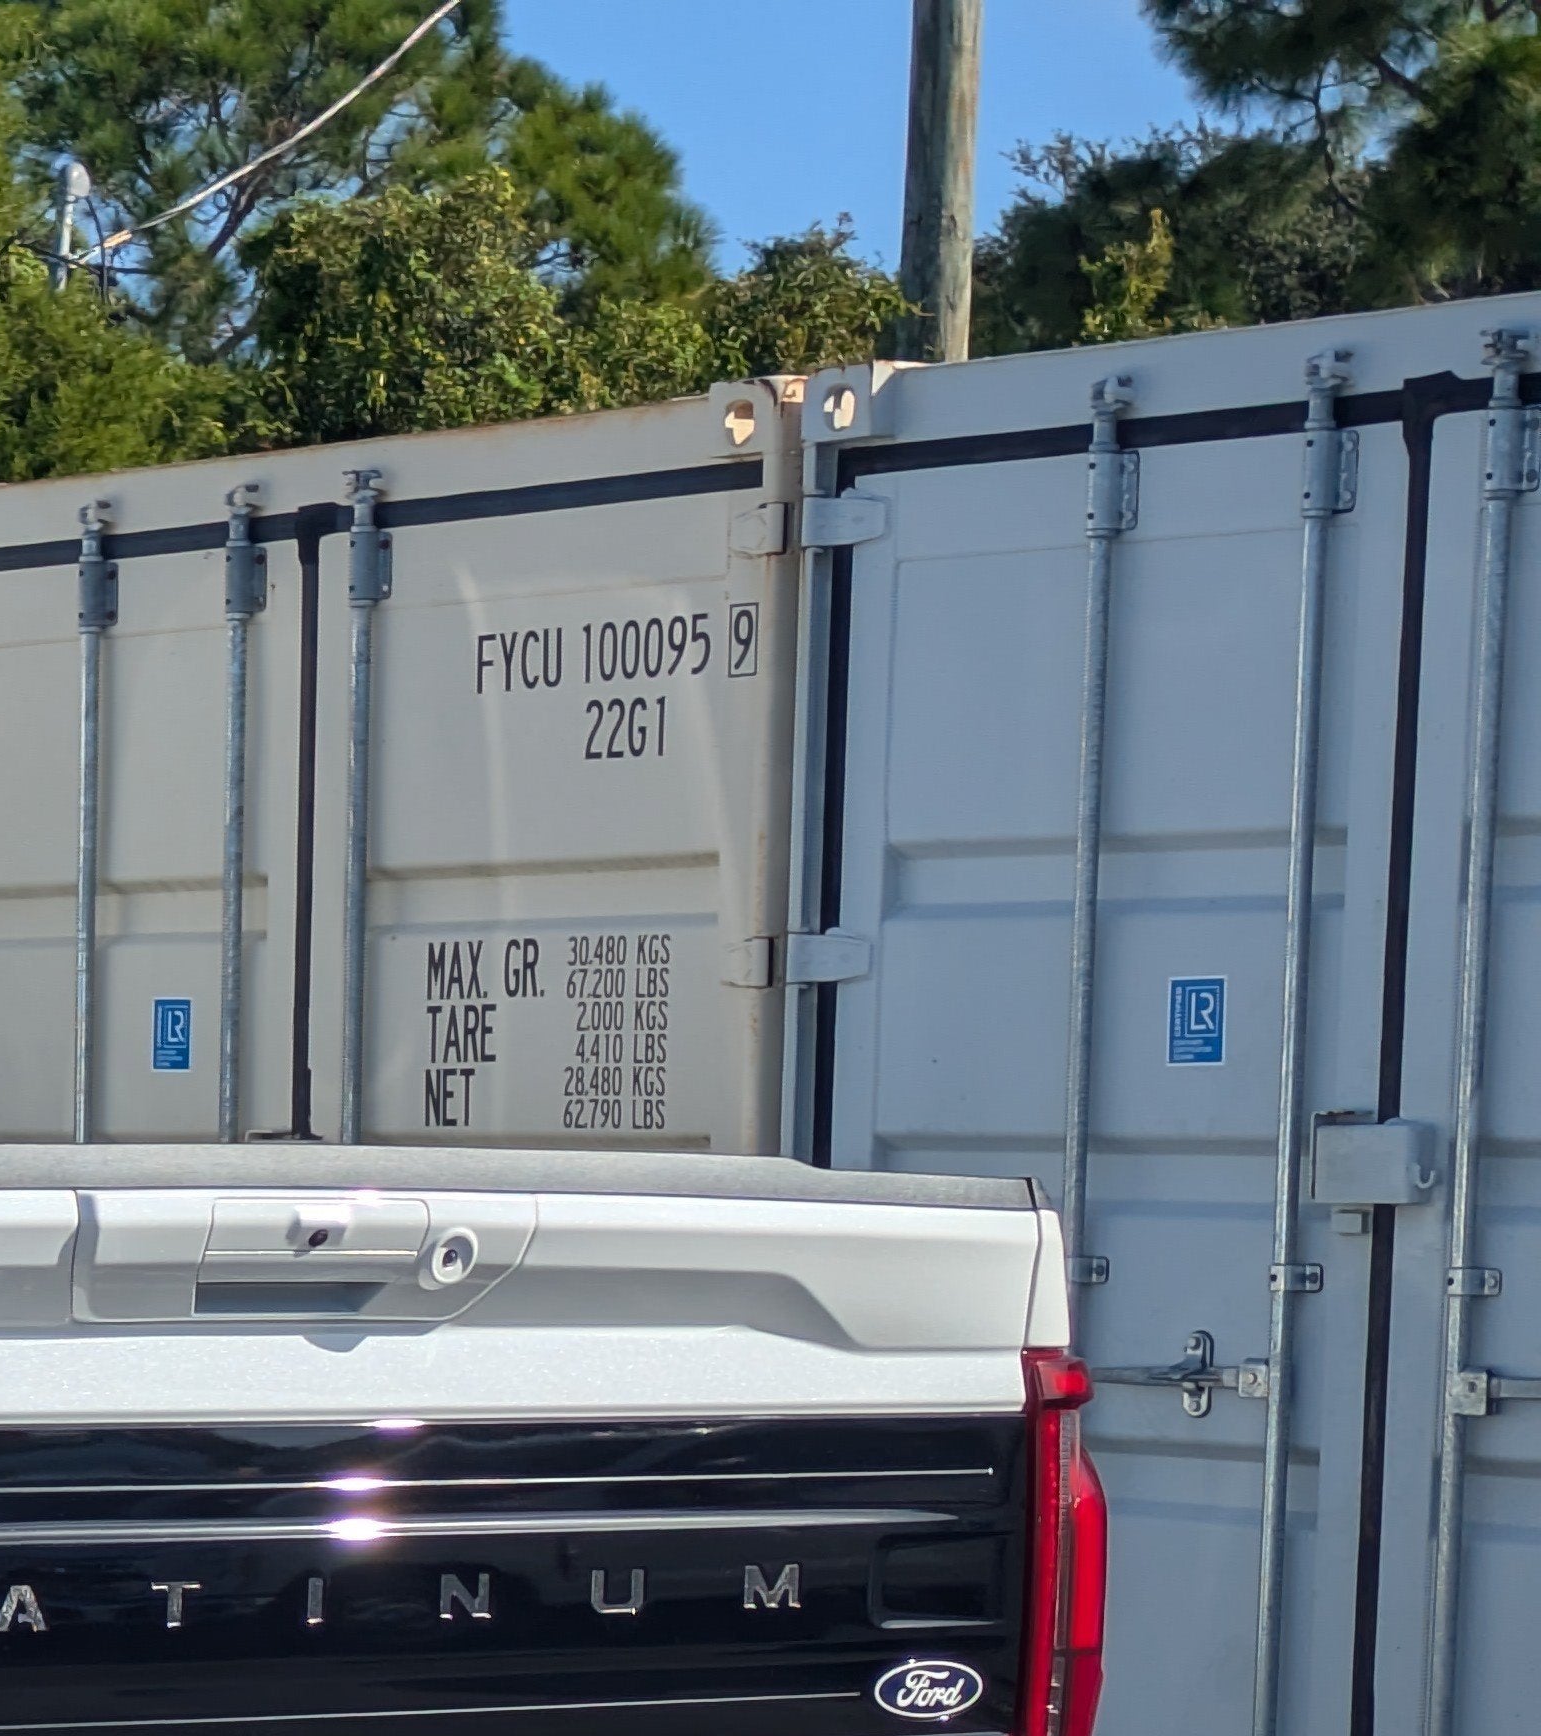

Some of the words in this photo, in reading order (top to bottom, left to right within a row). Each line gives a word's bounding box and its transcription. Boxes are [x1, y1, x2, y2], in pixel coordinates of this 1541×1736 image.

[476, 627, 562, 694] FYCU
[582, 613, 711, 683] 100095
[733, 609, 754, 670] 9
[584, 696, 666, 760] 22G1
[427, 940, 488, 1000] MAX.
[504, 938, 545, 998] GR.
[567, 935, 627, 966] 30.480
[637, 934, 671, 965] KGS
[566, 967, 626, 999] 67.200
[635, 967, 669, 998] LBS
[426, 1003, 497, 1063] TARE
[634, 1000, 668, 1031] KGS
[575, 1033, 623, 1064] 4.410
[633, 1033, 667, 1064] LBS
[424, 1068, 476, 1127] NET
[564, 1066, 622, 1097] 28.480
[632, 1066, 666, 1097] KGS
[632, 1099, 665, 1130] LBS
[896, 1670, 965, 1707] Ford
